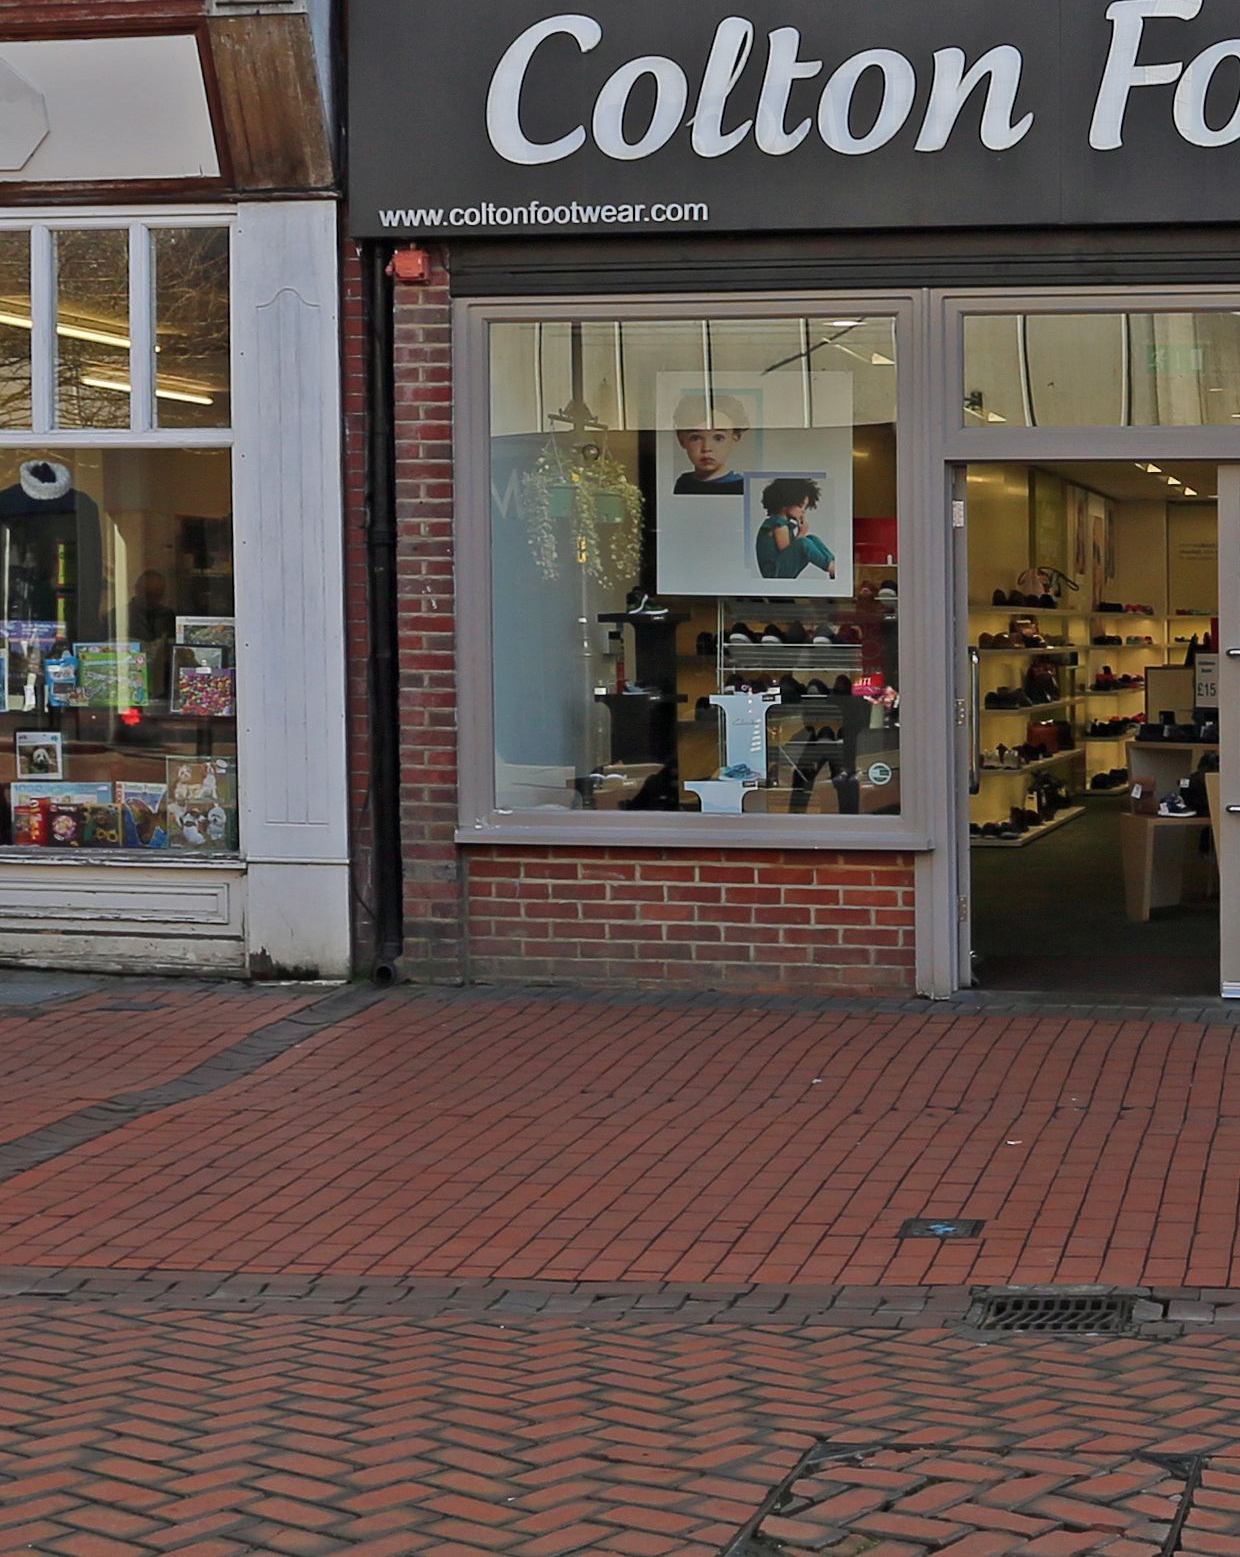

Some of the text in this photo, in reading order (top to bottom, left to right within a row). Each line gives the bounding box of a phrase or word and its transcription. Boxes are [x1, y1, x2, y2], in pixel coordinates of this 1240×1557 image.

[486, 14, 1034, 165] Colton
[379, 200, 708, 227] www.coltonfootwear.com
[1197, 682, 1217, 697] £15
